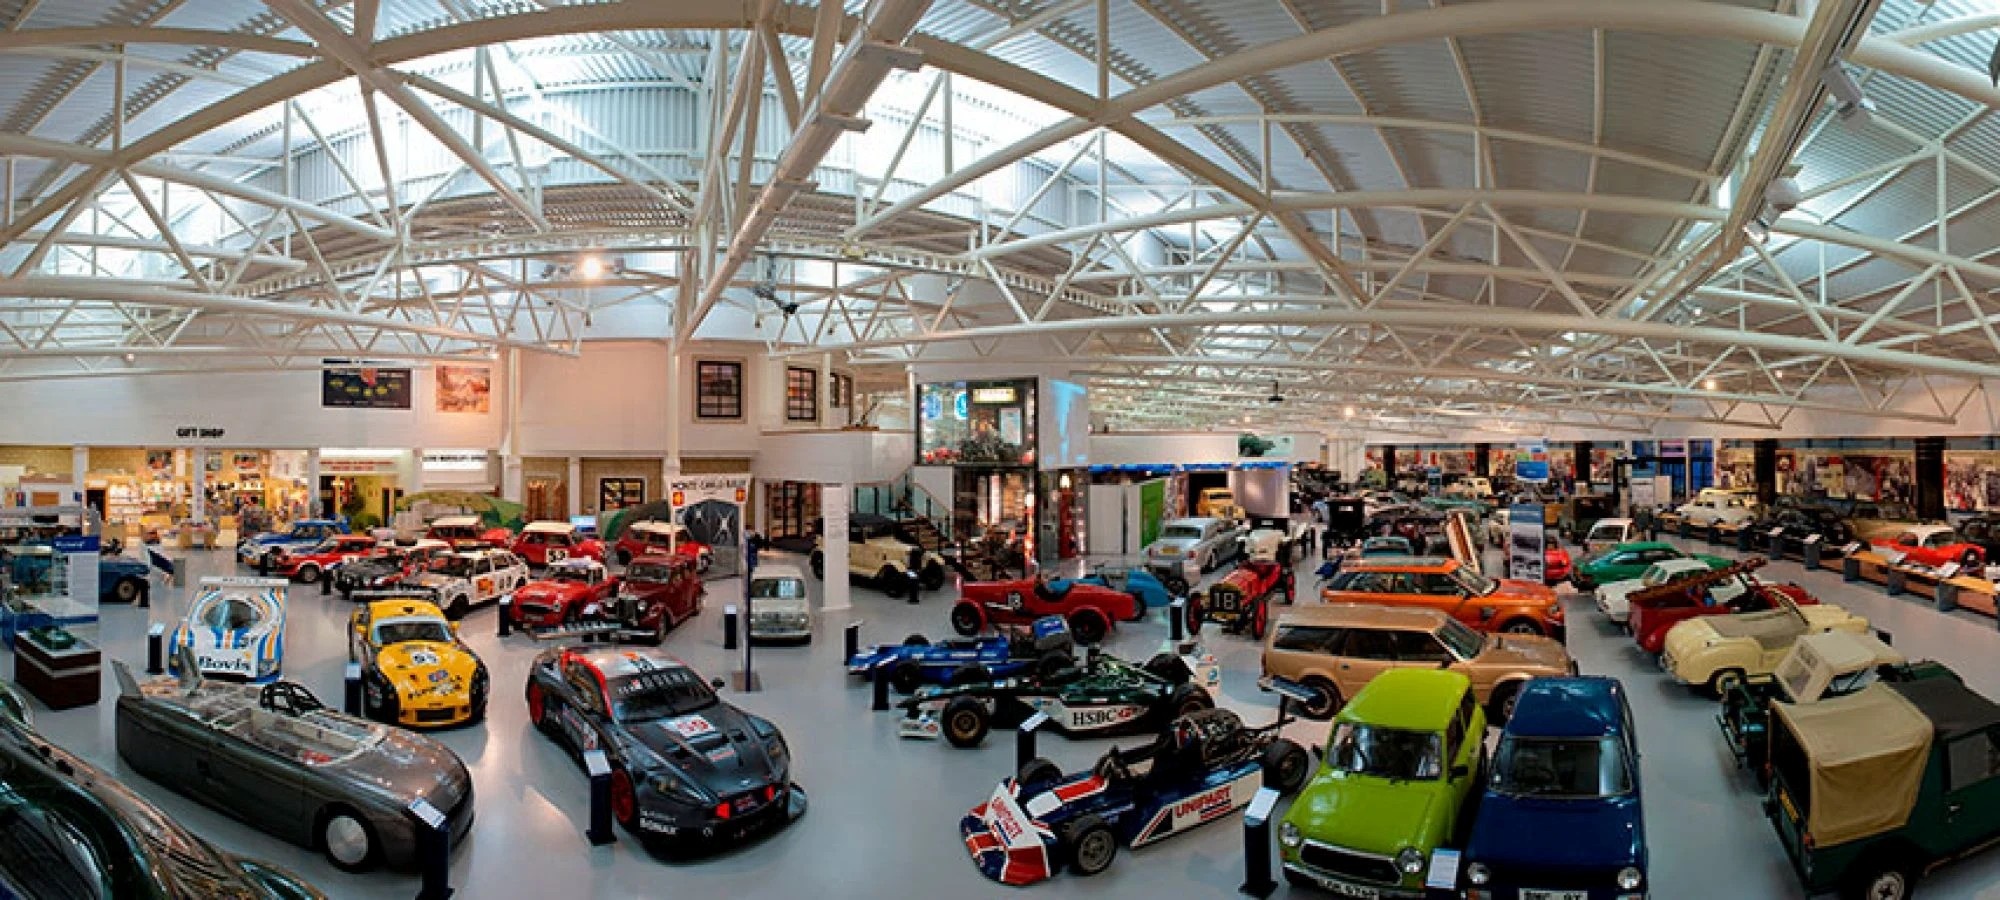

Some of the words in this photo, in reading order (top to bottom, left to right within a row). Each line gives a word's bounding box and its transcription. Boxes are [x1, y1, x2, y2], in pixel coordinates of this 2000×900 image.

[176, 428, 197, 438] GIFT
[199, 428, 225, 438] SHOP
[1213, 592, 1237, 610] 18
[1072, 707, 1117, 727] HSBC
[1174, 786, 1232, 818] UNIPART
